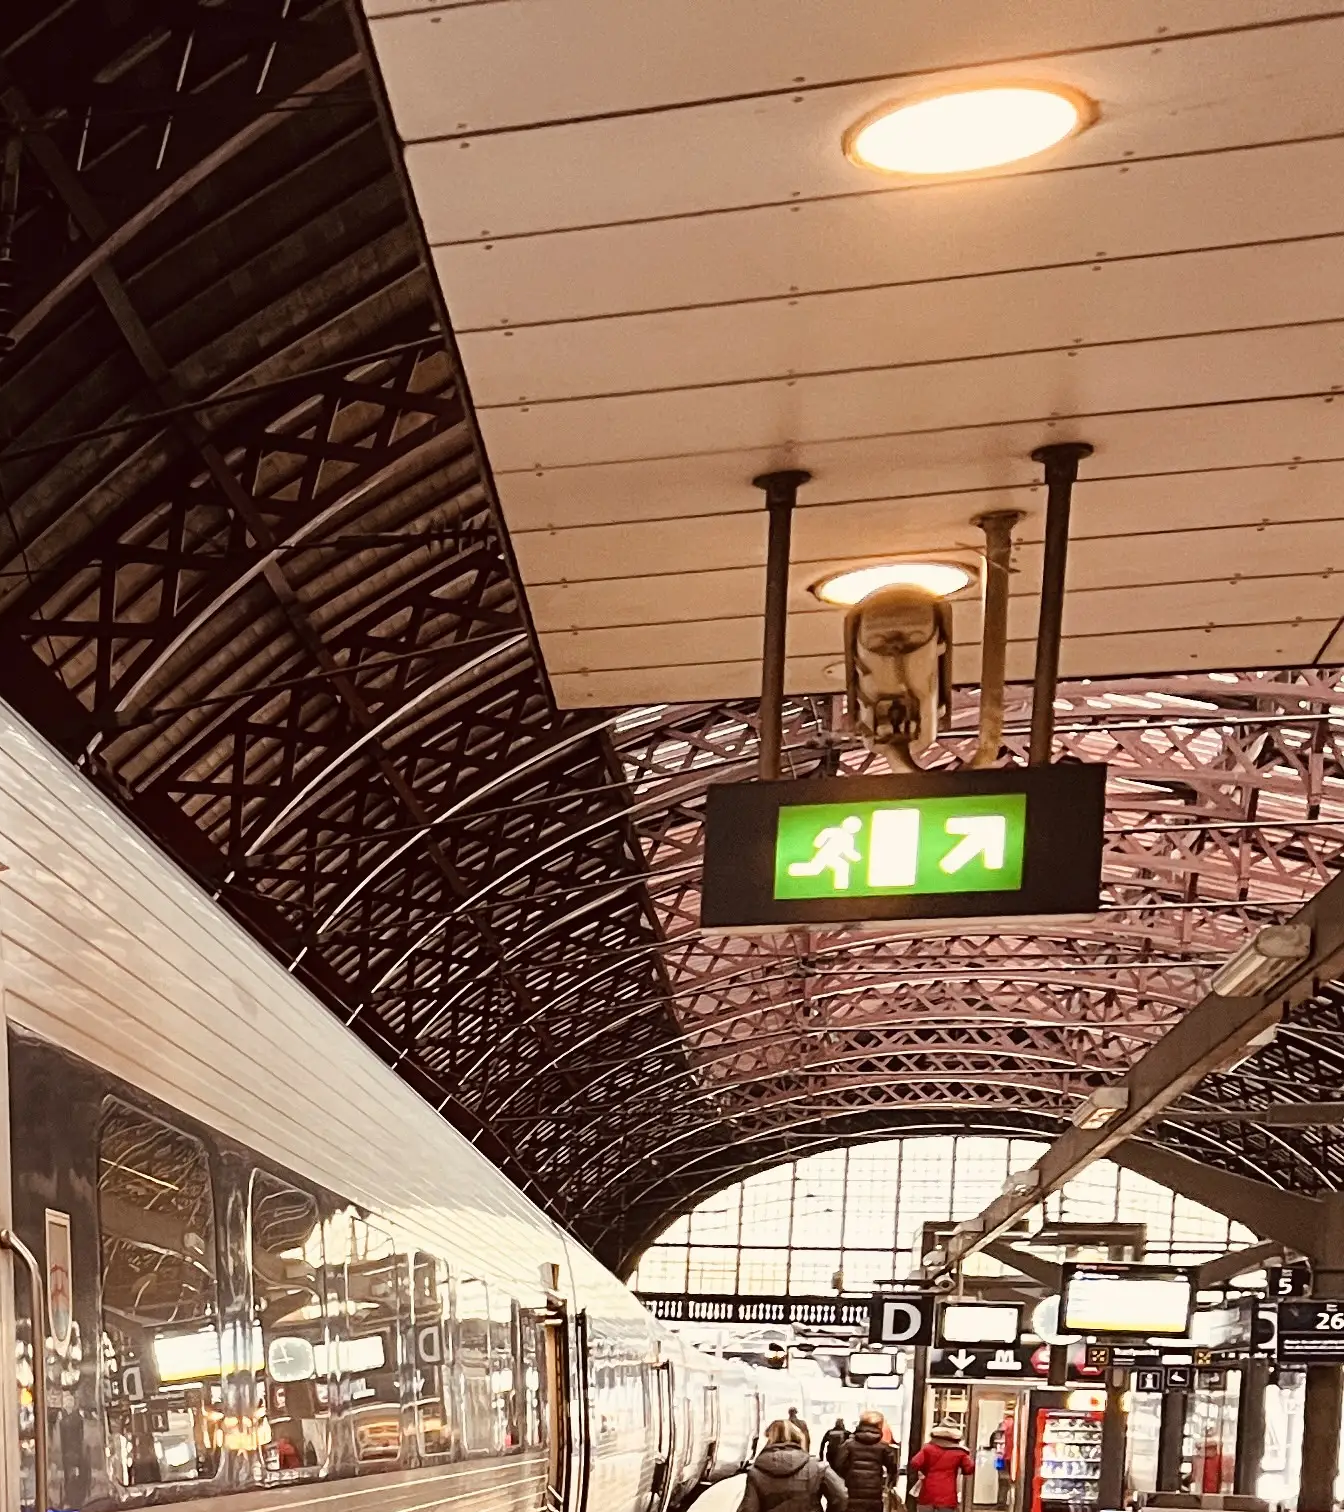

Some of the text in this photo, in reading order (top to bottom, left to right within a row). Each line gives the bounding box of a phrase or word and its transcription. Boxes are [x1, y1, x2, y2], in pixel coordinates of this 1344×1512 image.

[1278, 1278, 1293, 1295] 5
[882, 1303, 922, 1341] D
[1315, 1313, 1344, 1330] 26
